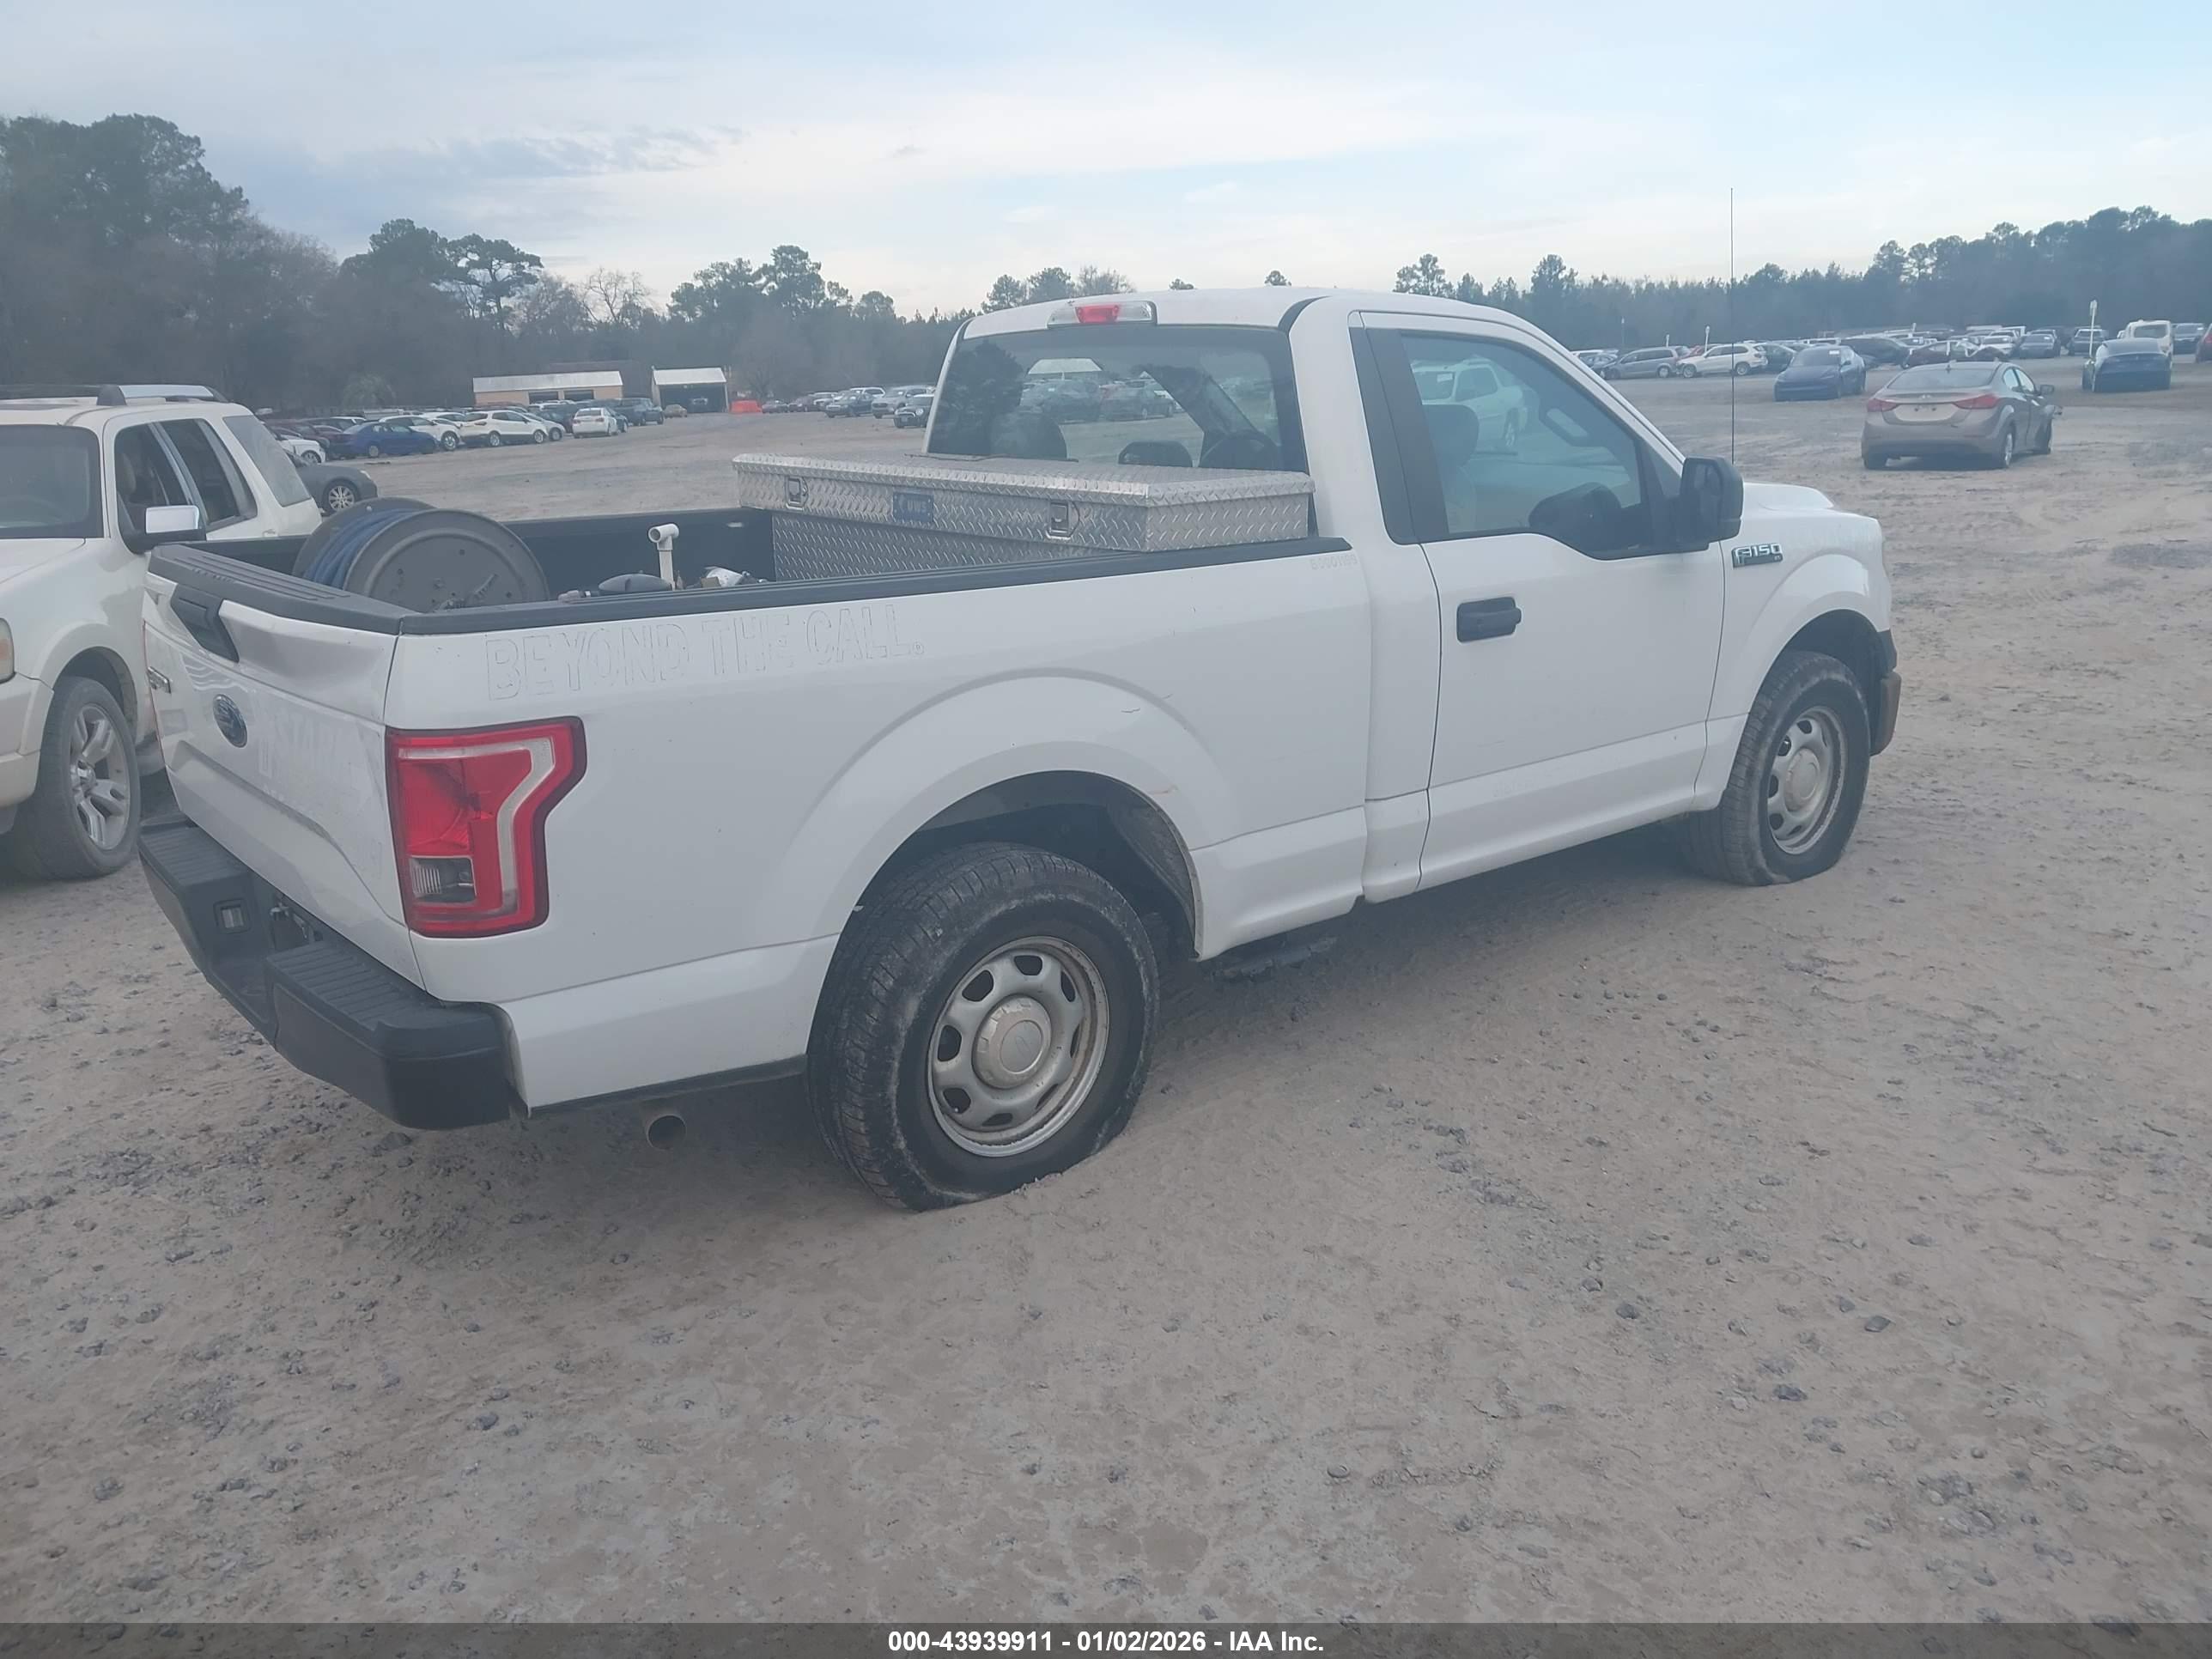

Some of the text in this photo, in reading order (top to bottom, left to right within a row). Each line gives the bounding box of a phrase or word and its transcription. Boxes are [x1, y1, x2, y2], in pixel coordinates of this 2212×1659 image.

[907, 500, 927, 514] UWS
[485, 623, 690, 701] BEYOND
[701, 613, 795, 675] THE
